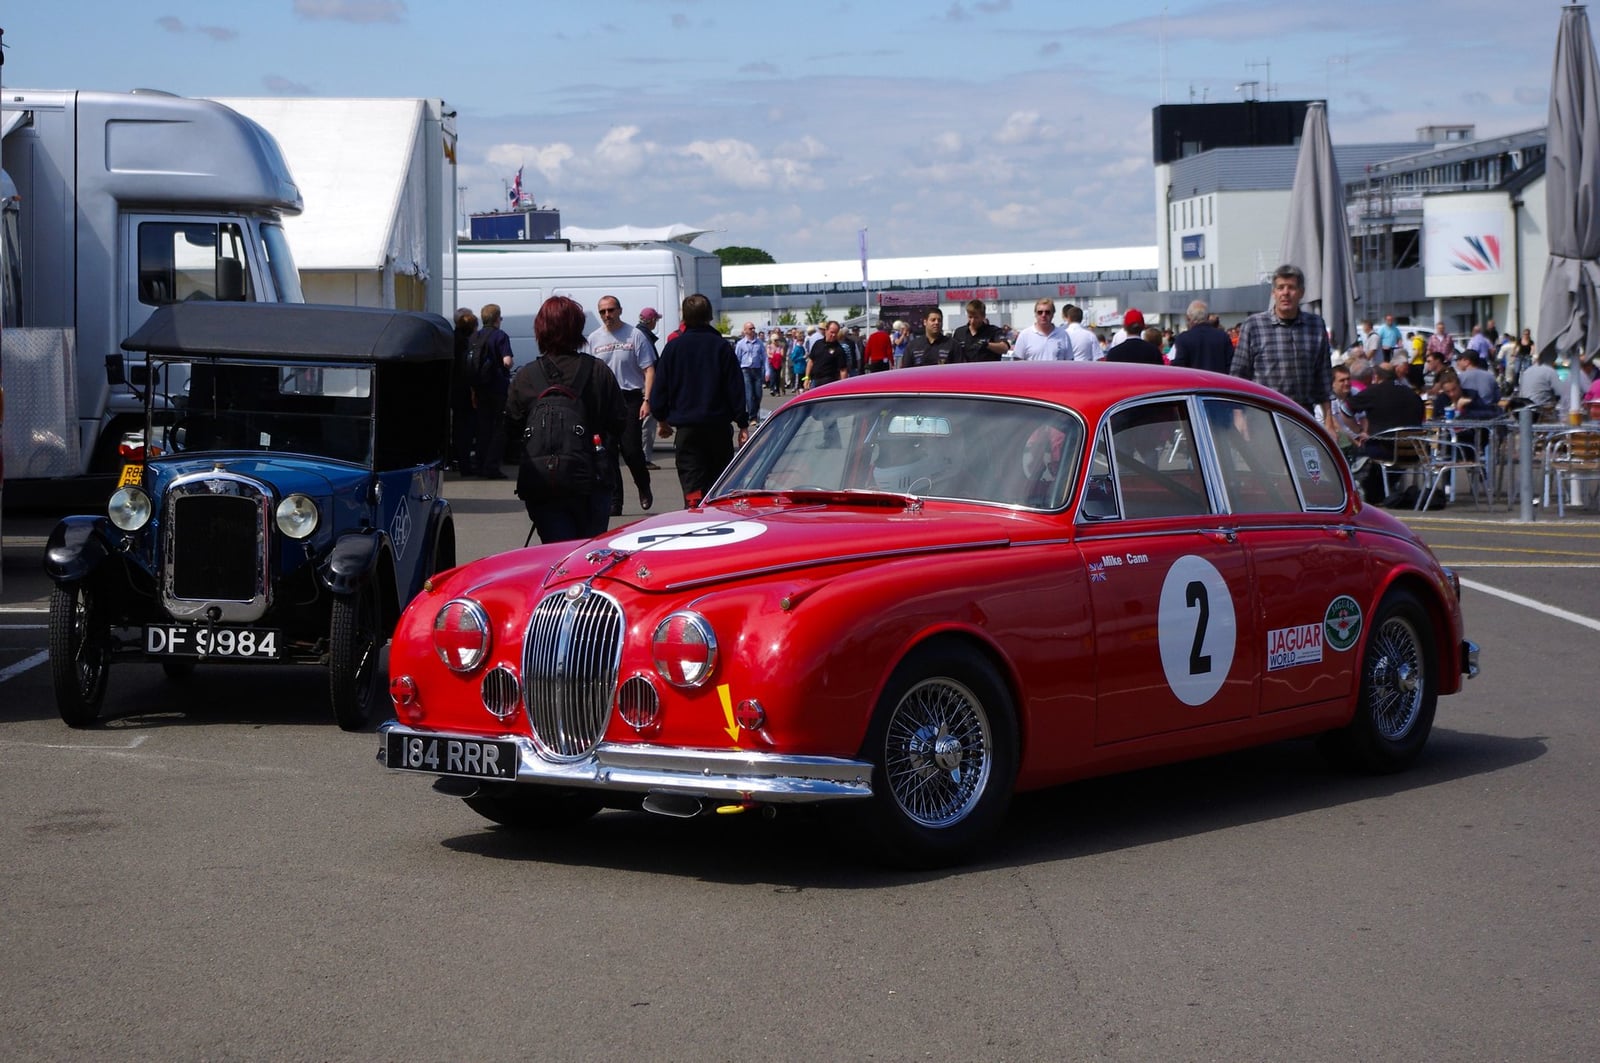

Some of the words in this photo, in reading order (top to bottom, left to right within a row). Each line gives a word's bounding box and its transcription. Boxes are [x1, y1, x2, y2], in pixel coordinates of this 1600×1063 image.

[1101, 555, 1123, 567] Mike
[1126, 553, 1149, 564] Cann
[1331, 599, 1355, 617] JAGUAR
[148, 626, 187, 653] DF
[195, 629, 277, 657] 9984
[1185, 580, 1212, 676] 2
[1270, 625, 1321, 655] JAGUAR
[1270, 652, 1296, 666] WORLD
[402, 736, 440, 769] 184
[447, 740, 499, 775] RRR
